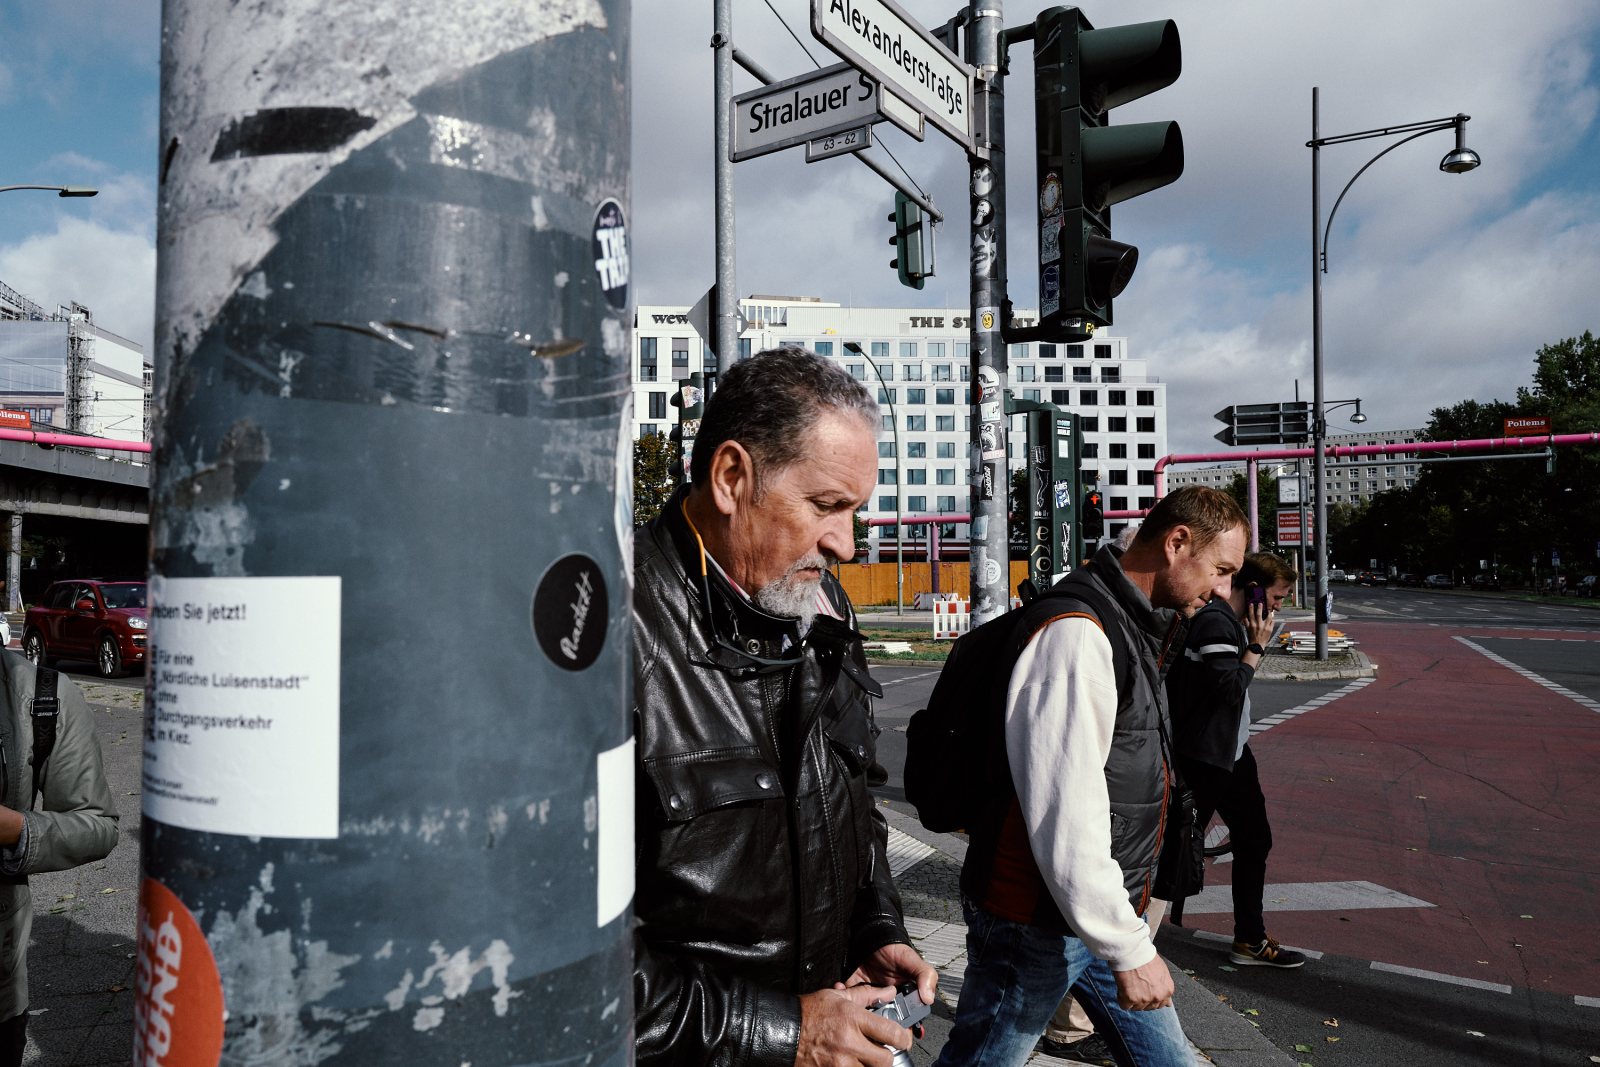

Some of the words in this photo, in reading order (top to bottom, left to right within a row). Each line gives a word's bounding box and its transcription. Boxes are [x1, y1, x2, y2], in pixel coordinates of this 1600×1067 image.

[829, 0, 963, 116] Alexanderstraße
[749, 83, 851, 134] Stralauer
[823, 137, 835, 151] 63
[844, 133, 856, 146] 62
[909, 316, 945, 328] THE
[952, 316, 1035, 329] STNT
[1507, 419, 1546, 428] Pollems
[183, 602, 203, 620] Sie
[207, 602, 246, 624] jetzt!
[174, 652, 195, 666] eine
[157, 707, 273, 731] Durchgangsverkehr
